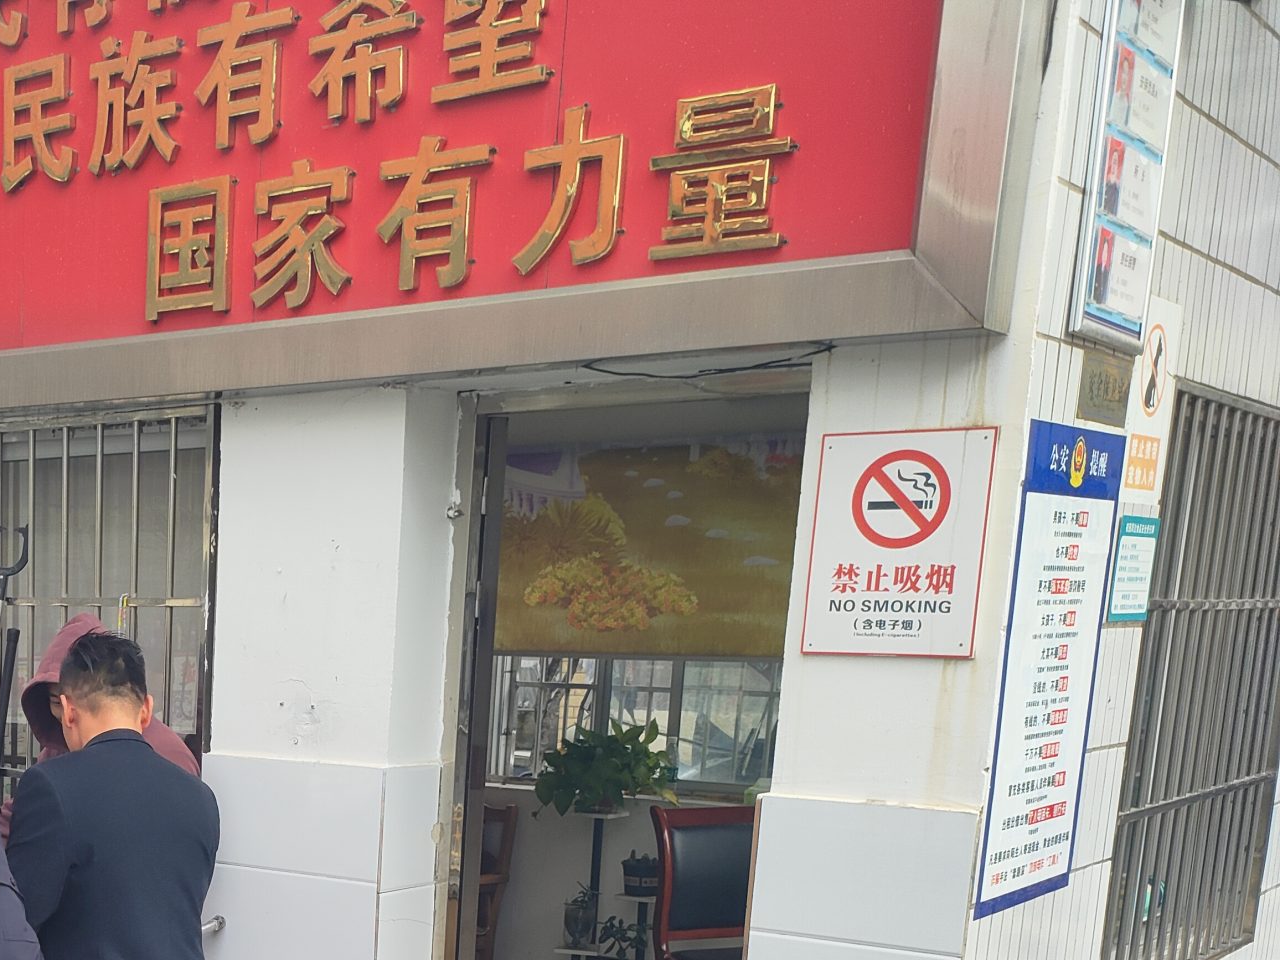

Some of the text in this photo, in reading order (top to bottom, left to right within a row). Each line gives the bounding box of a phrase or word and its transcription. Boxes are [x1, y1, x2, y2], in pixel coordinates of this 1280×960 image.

[0, 0, 554, 194] 民族有希望
[145, 83, 798, 322] 国家有力量
[1050, 443, 1108, 477] 公安 提醒
[831, 563, 956, 594] 禁止吸烟
[829, 600, 952, 613] NO SMOKING
